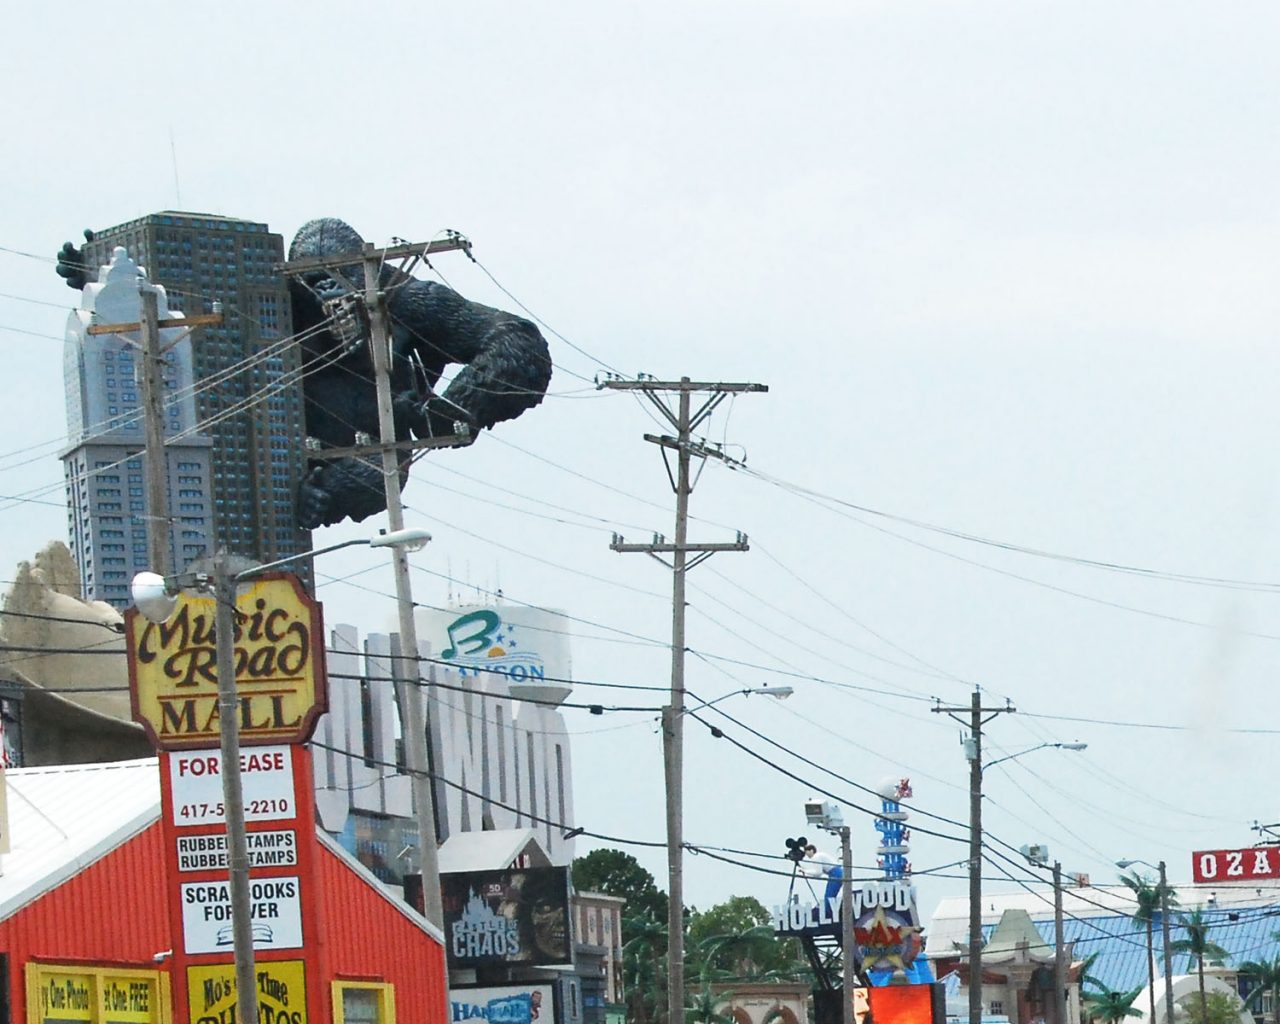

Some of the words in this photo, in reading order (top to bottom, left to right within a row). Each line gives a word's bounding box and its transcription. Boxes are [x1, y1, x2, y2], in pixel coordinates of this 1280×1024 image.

[178, 757, 220, 777] FOR
[239, 753, 284, 773] EASE
[180, 798, 288, 819] 417-5-2210
[245, 833, 293, 849] TAMPS
[181, 853, 230, 868] RUBBE
[247, 849, 295, 865] TAMPS
[186, 882, 296, 904] SCRAOOKS
[204, 902, 280, 922] FORVER
[452, 919, 506, 933] CASTLE
[452, 931, 520, 958] CHAOS
[203, 976, 232, 1013] Mo's
[257, 971, 288, 1008] Time
